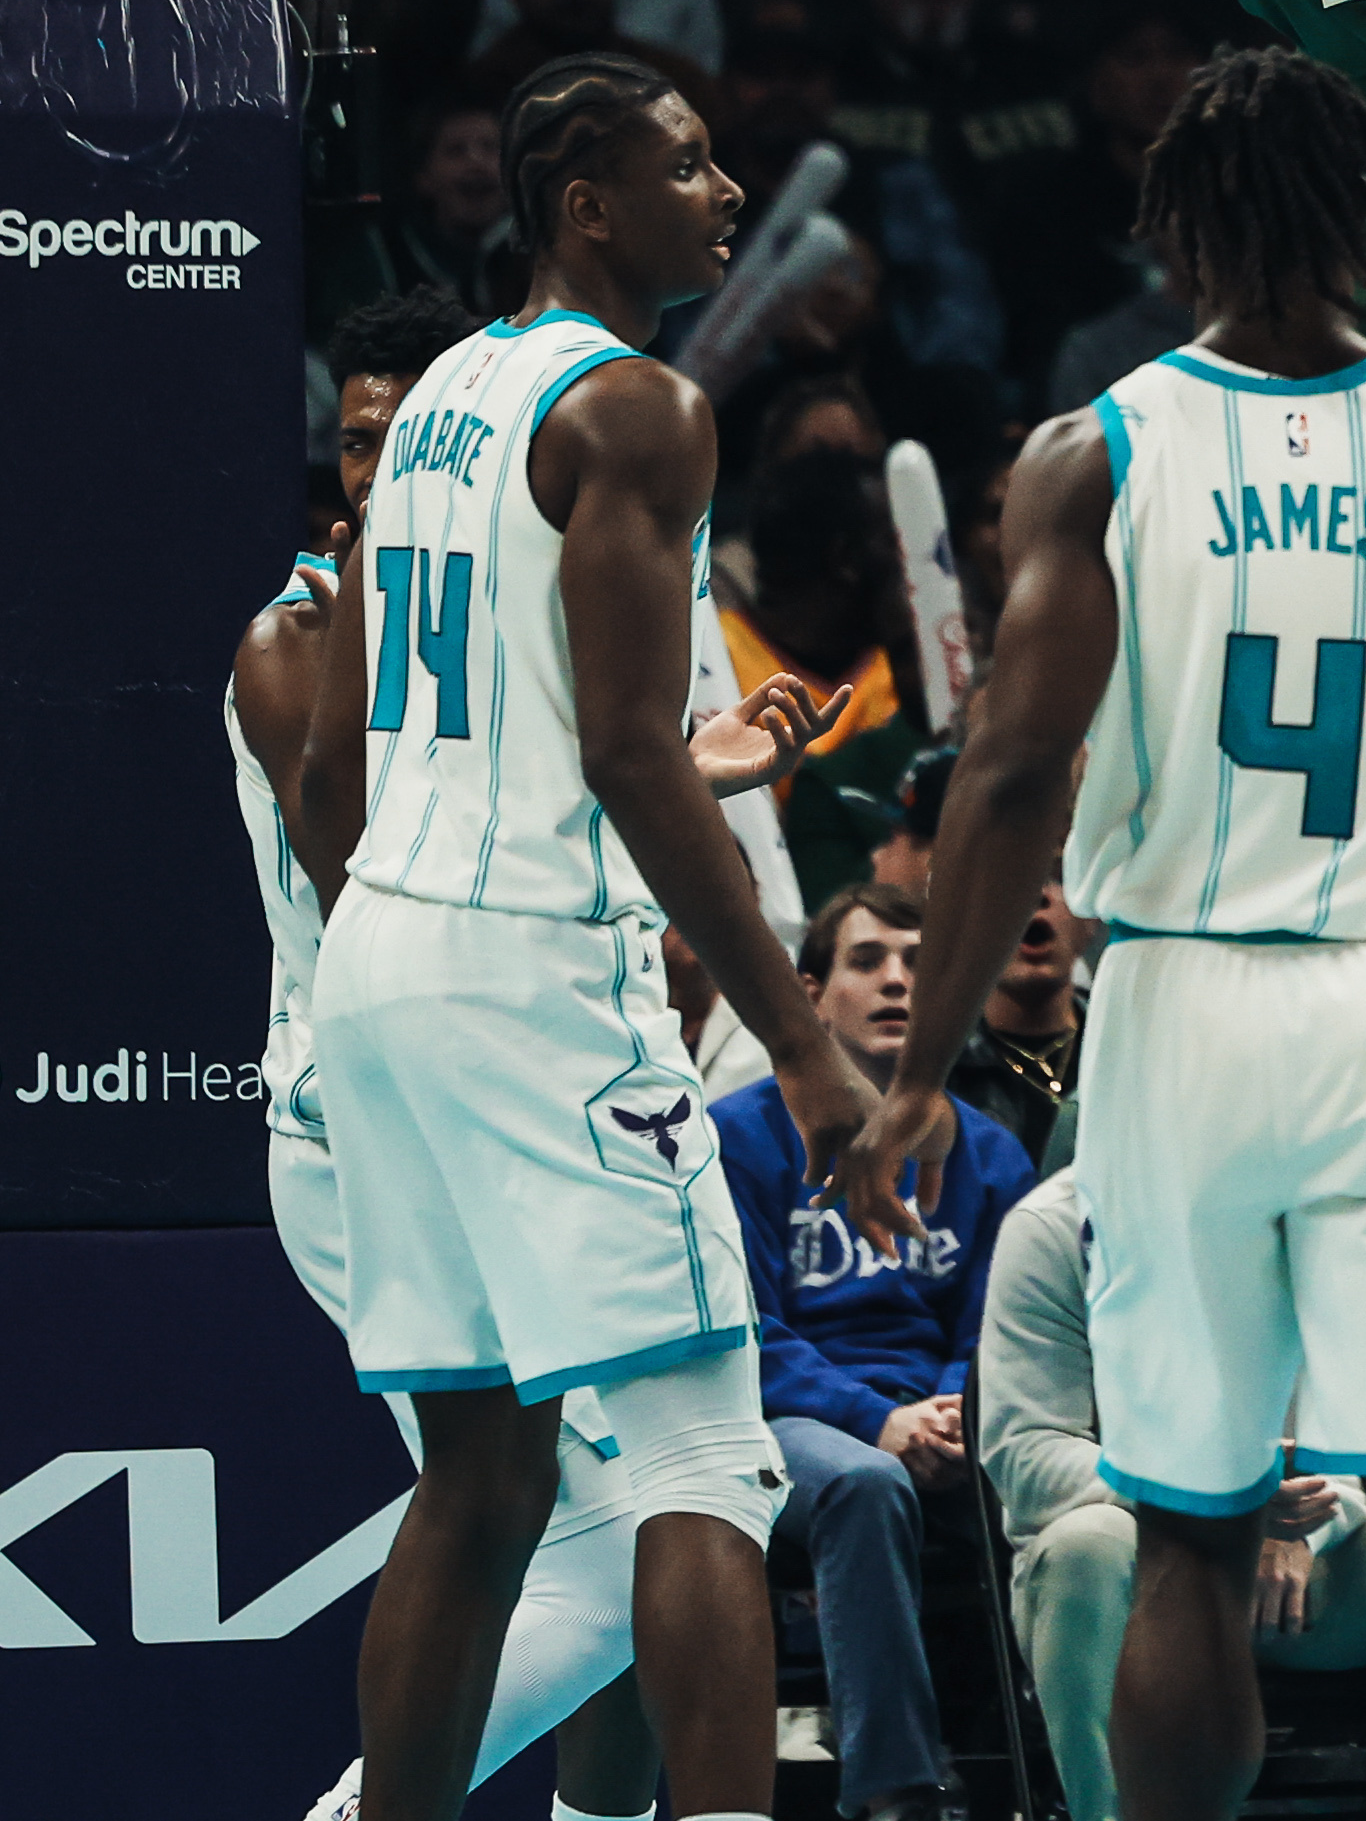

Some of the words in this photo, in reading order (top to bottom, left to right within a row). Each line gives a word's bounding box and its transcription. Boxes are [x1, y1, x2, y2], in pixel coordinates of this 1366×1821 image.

[0, 209, 242, 268] Spectrum
[126, 264, 242, 289] CENTER
[392, 409, 494, 489] DIABATE
[368, 546, 473, 739] 14
[15, 1047, 148, 1103] Judi
